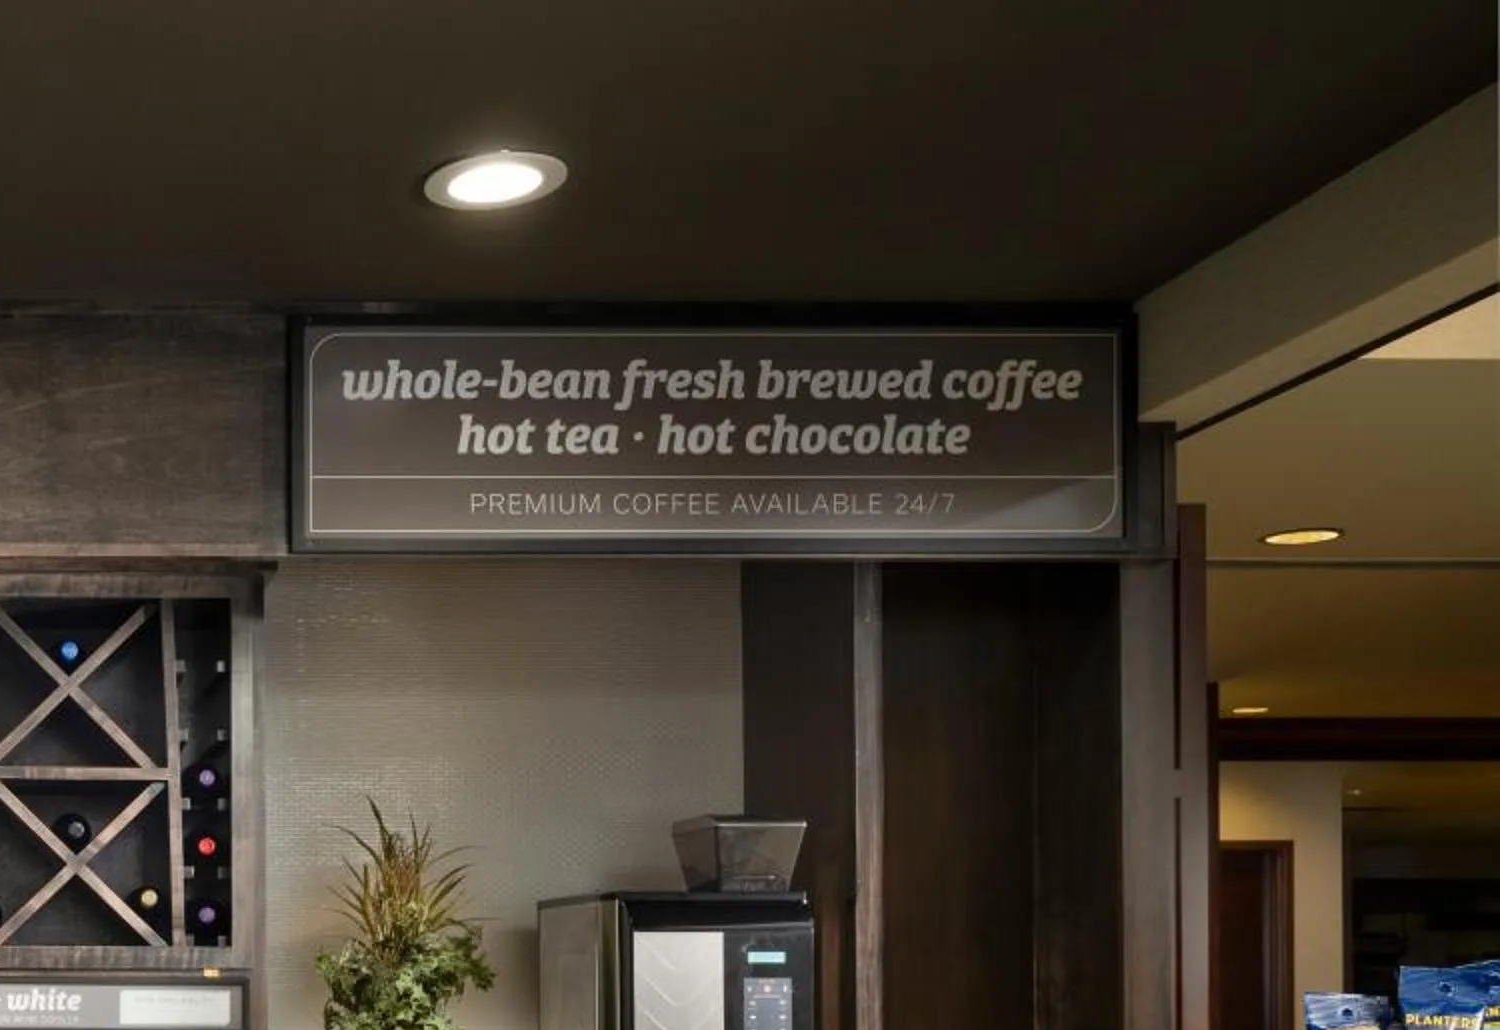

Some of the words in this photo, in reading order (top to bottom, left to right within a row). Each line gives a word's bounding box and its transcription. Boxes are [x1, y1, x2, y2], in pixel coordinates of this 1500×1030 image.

[342, 359, 611, 400] whole-bean
[613, 359, 746, 411] fresh
[756, 359, 934, 400] brewed
[941, 359, 1084, 411] coffee
[457, 413, 536, 455] hot
[546, 418, 620, 455] tea
[656, 413, 736, 455] hot
[744, 413, 972, 455] chocolate
[469, 493, 601, 515] PREMIUM
[612, 493, 720, 515] COFFEE
[730, 493, 884, 515] AVAILABLE
[894, 493, 956, 515] 24/7
[6, 987, 83, 1012] white
[1404, 1013, 1478, 1028] PLANTERS
